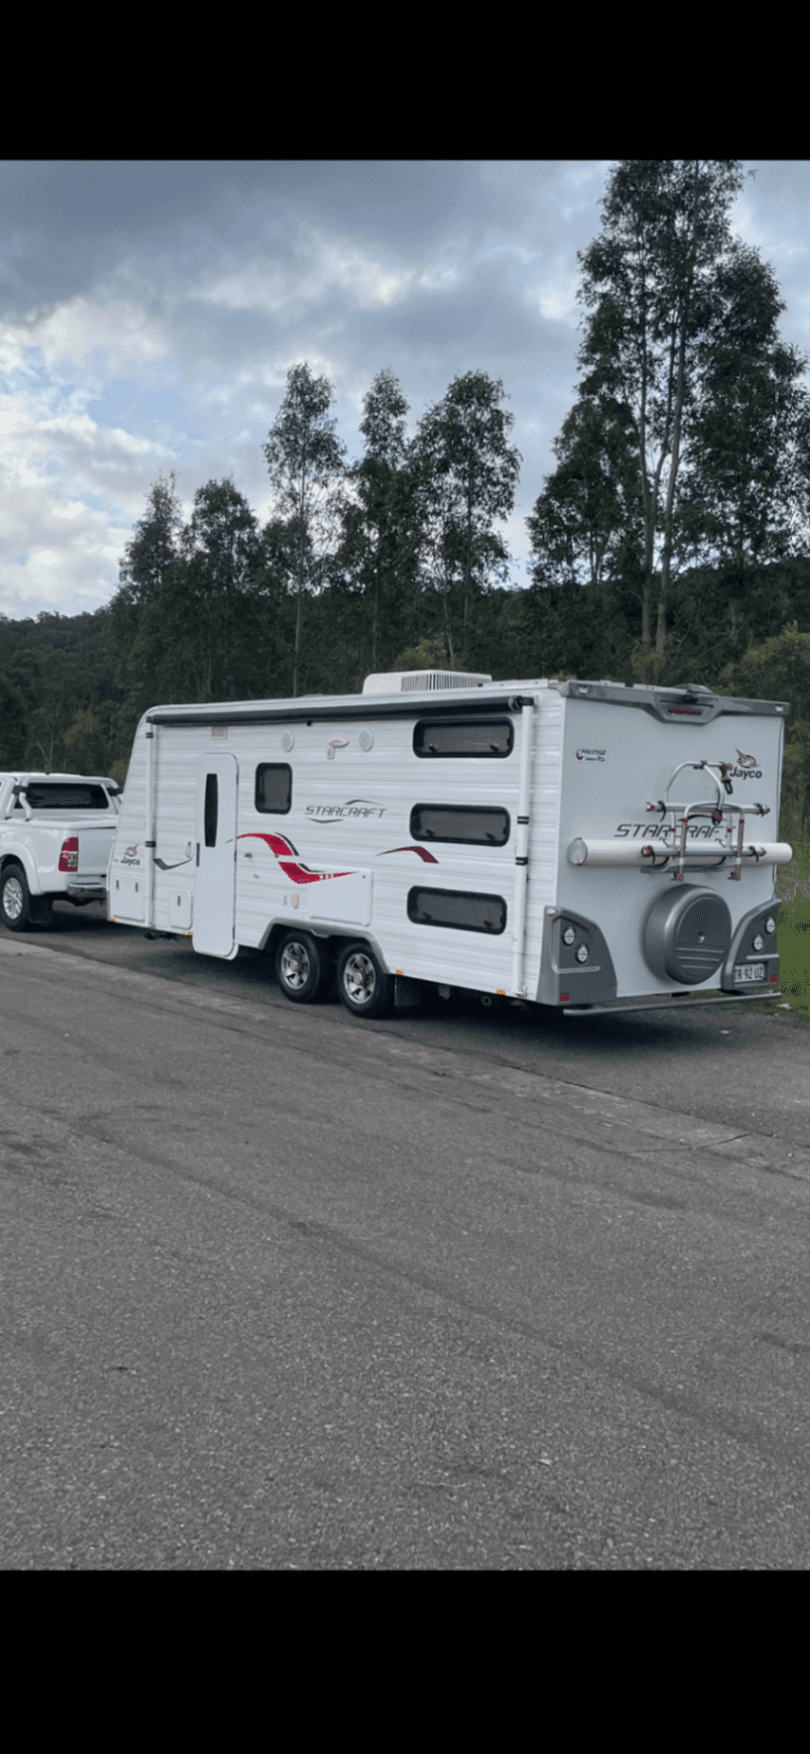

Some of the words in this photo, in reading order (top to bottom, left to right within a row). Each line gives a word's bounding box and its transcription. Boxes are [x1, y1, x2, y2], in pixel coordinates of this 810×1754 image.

[730, 766, 762, 780] Jayco
[304, 805, 387, 818] STARCRAFT
[120, 856, 141, 866] Jayco
